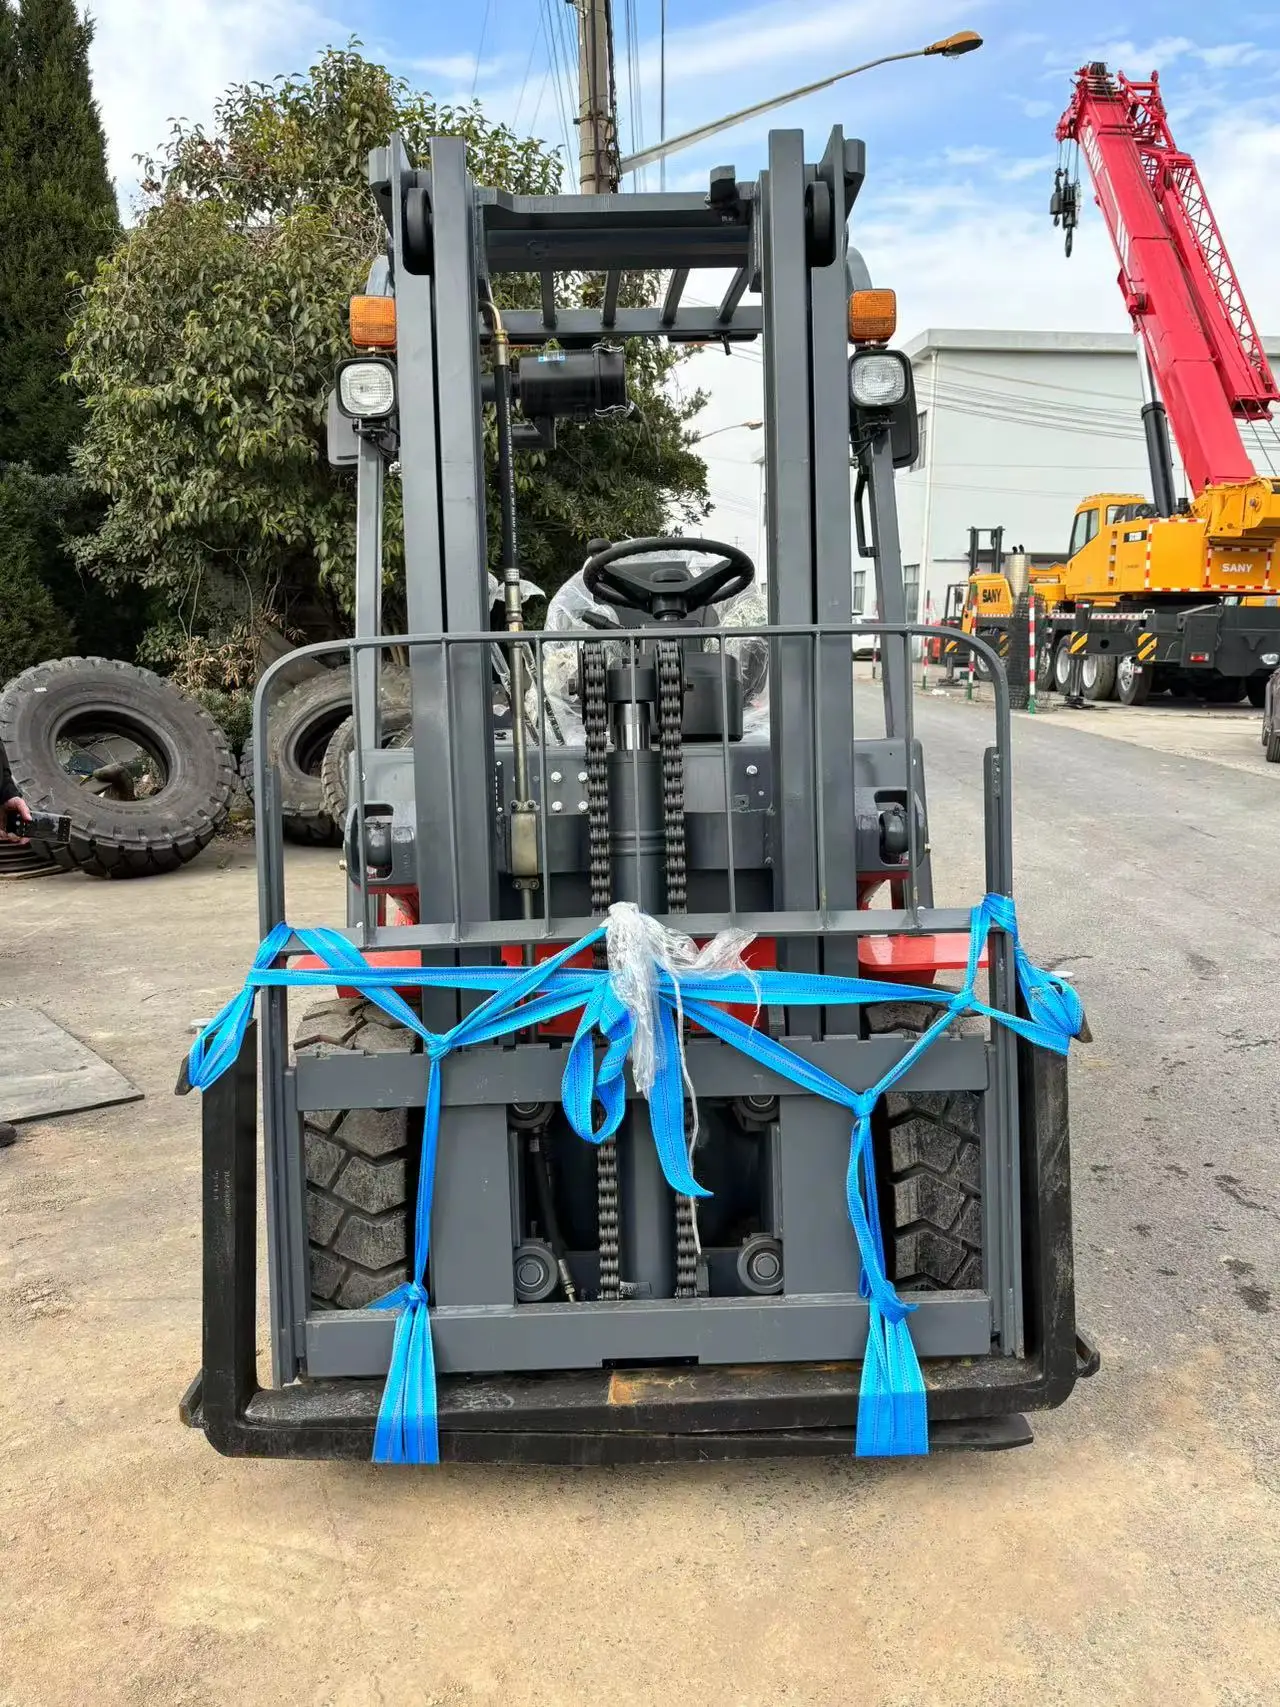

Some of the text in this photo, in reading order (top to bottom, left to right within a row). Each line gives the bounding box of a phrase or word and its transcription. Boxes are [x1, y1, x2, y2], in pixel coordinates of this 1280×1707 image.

[1083, 125, 1104, 177] SANY
[1222, 563, 1253, 573] SANY
[982, 588, 1002, 603] SANY
